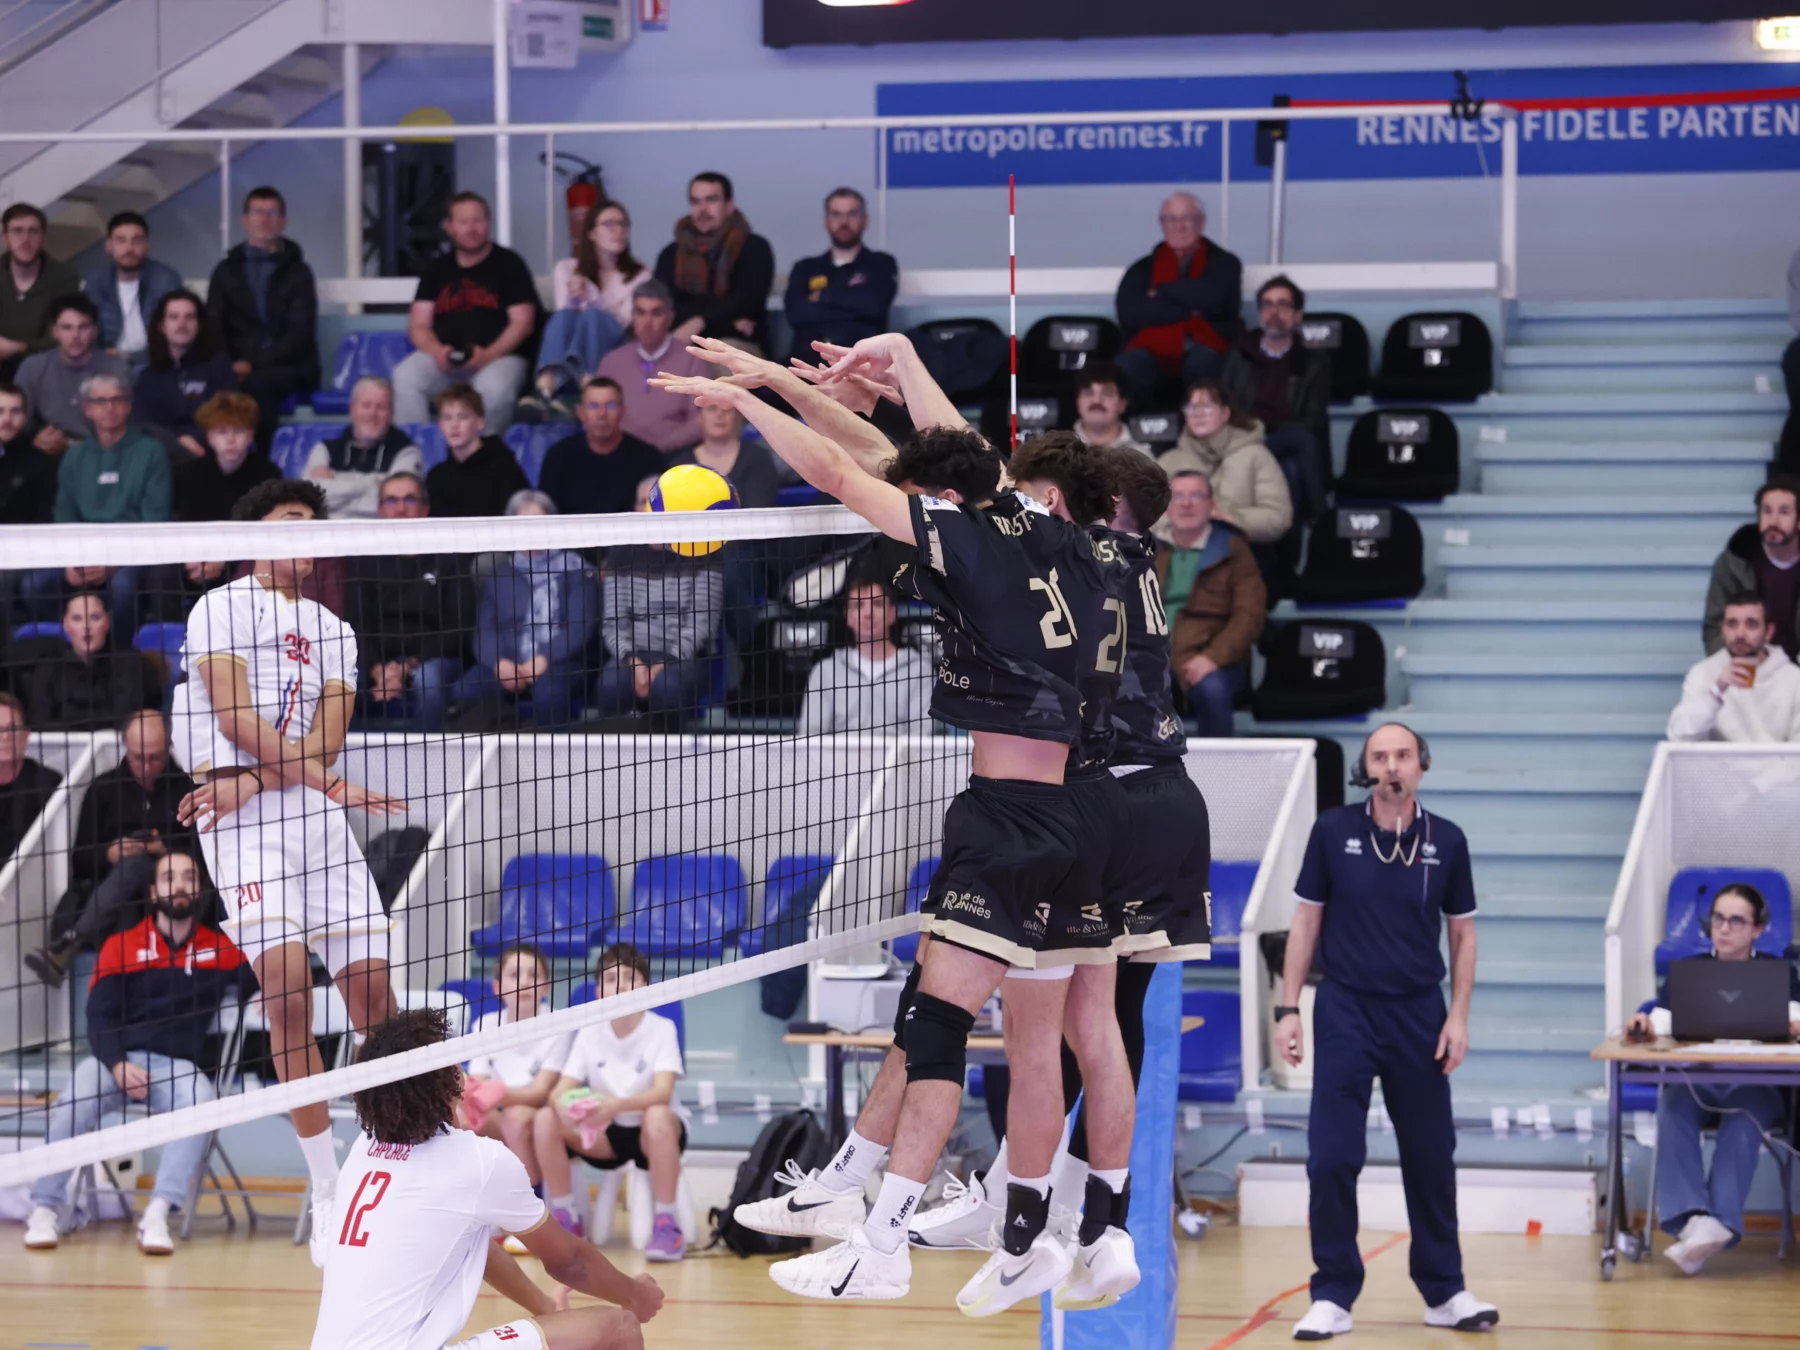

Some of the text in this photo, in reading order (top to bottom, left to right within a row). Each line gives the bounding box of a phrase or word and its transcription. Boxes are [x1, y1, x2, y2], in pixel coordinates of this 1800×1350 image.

[1357, 104, 1800, 146] RENNES FIDELE PARTEN
[893, 120, 1208, 158] metropole.rennes.fr
[1420, 323, 1450, 340] VIP
[1139, 417, 1169, 434] VIP
[1390, 420, 1420, 436] VIP
[1349, 514, 1380, 530] VIP
[1138, 567, 1169, 636] 10
[1313, 632, 1344, 650] VIP
[235, 881, 262, 910] 20
[972, 895, 986, 906] de
[842, 1144, 856, 1167] CRAFT
[338, 1170, 392, 1248] 12
[897, 1195, 916, 1220] CRAFT
